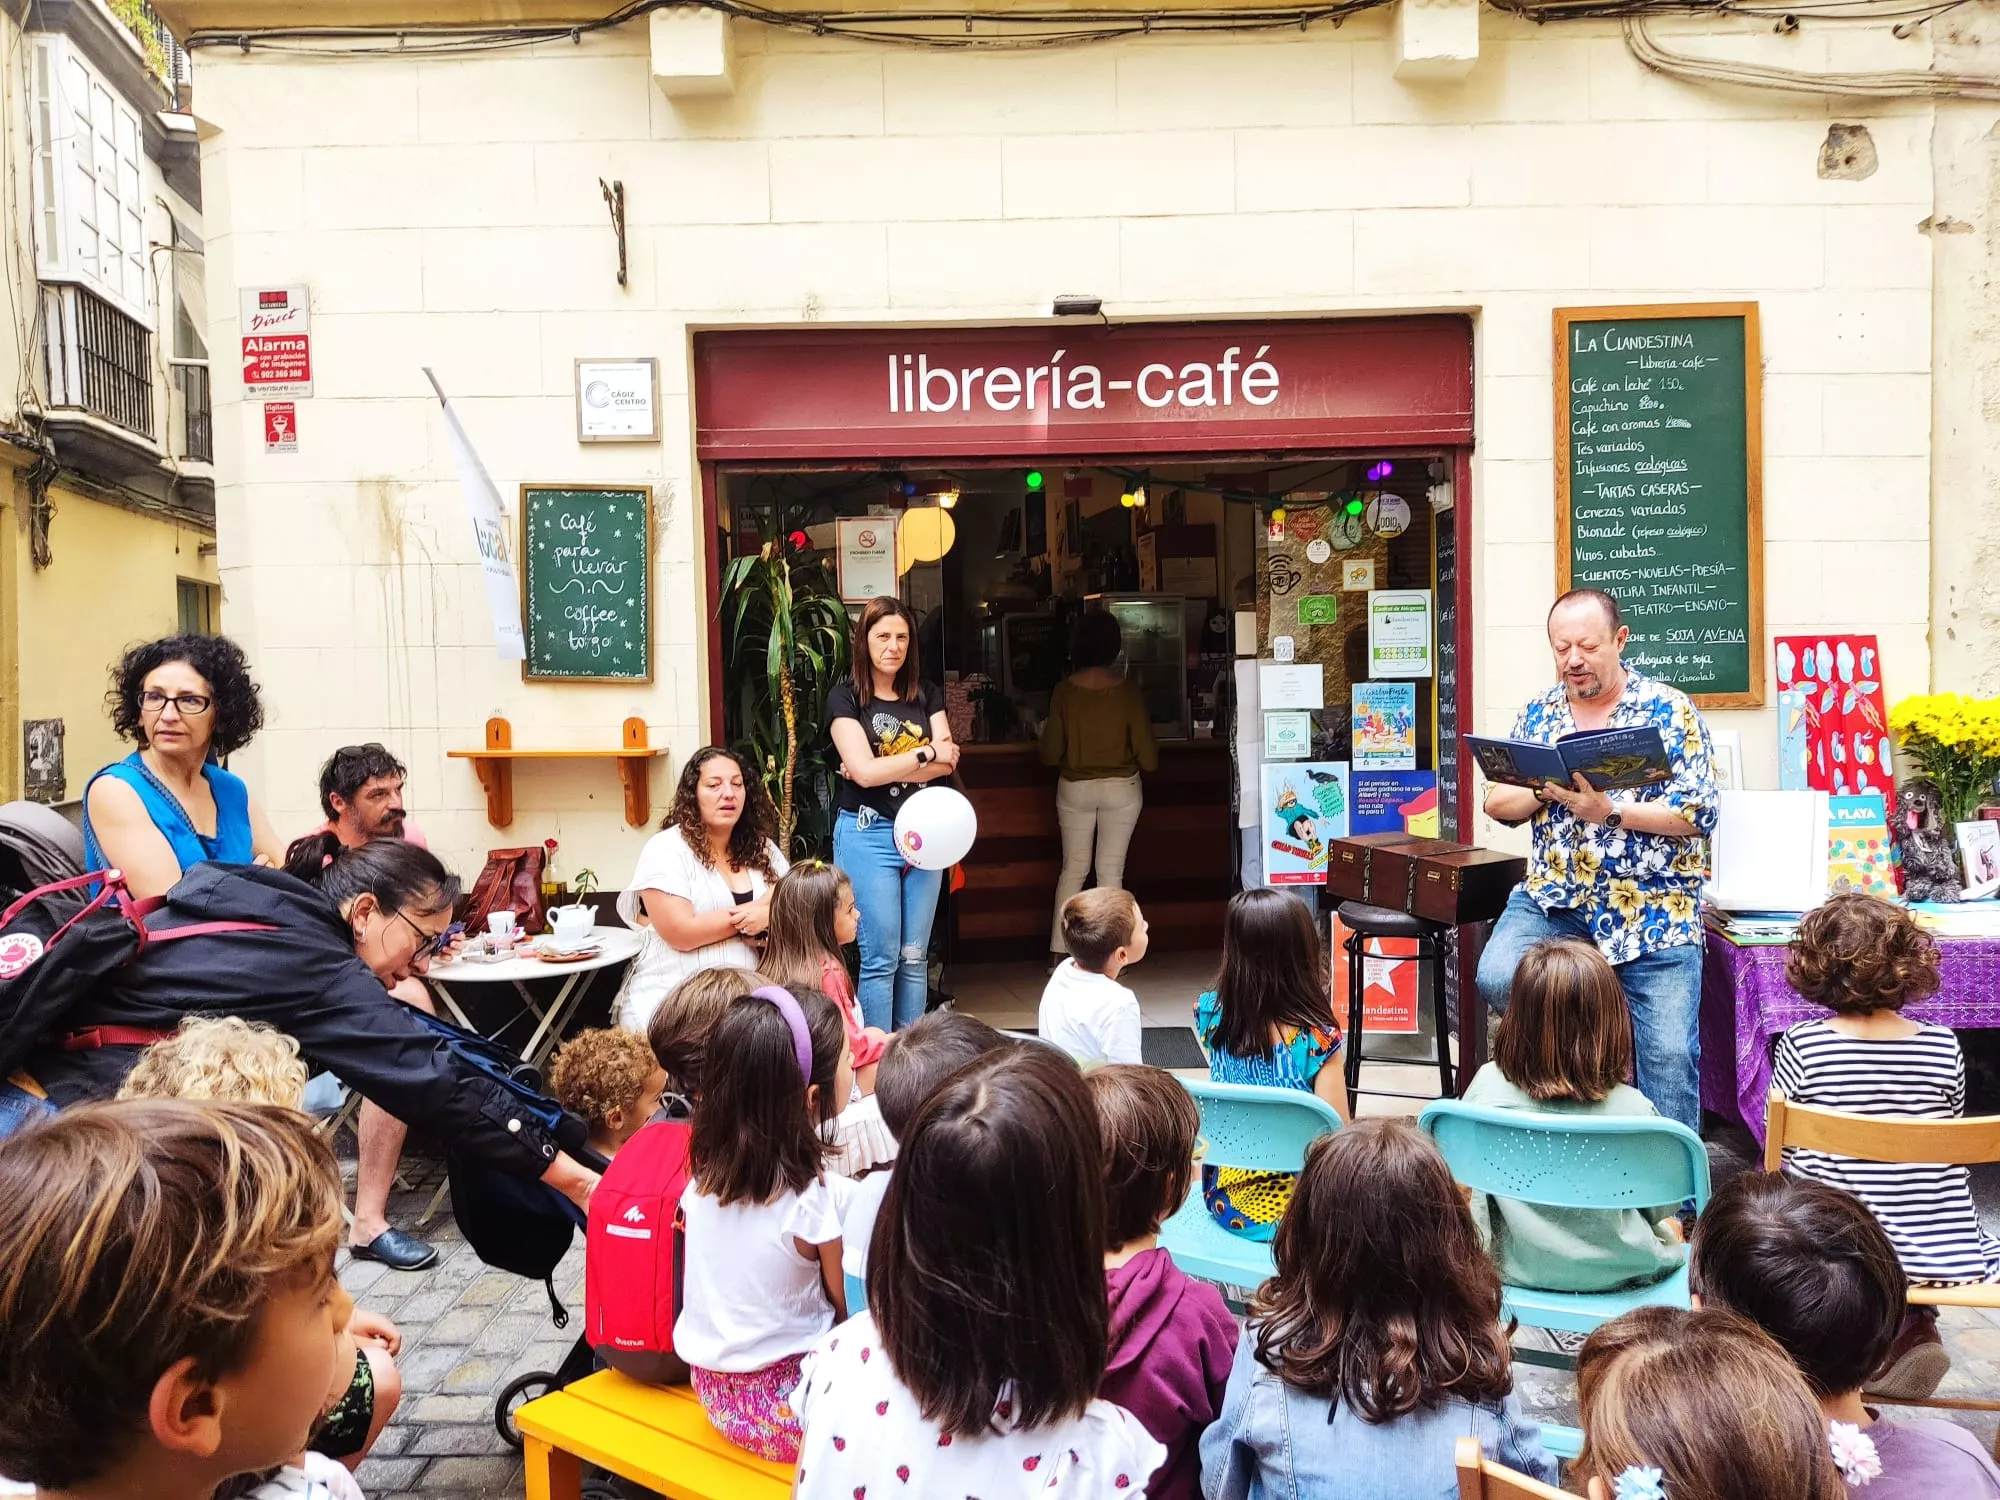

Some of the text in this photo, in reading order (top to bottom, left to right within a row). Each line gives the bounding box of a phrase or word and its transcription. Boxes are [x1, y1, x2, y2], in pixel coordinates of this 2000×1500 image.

[251, 307, 302, 331] Direct
[245, 338, 306, 352] Alarma
[1575, 328, 1694, 353] LA CLANDESTINA
[271, 359, 306, 369] imágenes
[273, 352, 306, 363] grabación
[260, 370, 274, 378] 902
[887, 344, 1280, 413] librería-café
[611, 389, 635, 398] CÁDIZ
[1572, 377, 1597, 396] Café
[1602, 382, 1621, 393] con
[614, 398, 647, 406] CENTRO
[1573, 398, 1629, 420] Capuchino
[1572, 419, 1598, 437] Café
[1602, 421, 1620, 432] con
[1622, 418, 1660, 431] aromas
[1575, 437, 1645, 455] Tés variados
[1575, 455, 1688, 477] Infusiones ecológicas
[1575, 500, 1687, 520] Cervezas variadas
[560, 511, 597, 545] Café
[1577, 521, 1626, 539] Bionade
[553, 544, 601, 568] para
[564, 605, 618, 634] coffee
[568, 630, 611, 658] to go
[1626, 631, 1646, 642] ECHE
[1649, 631, 1660, 642] DE
[1675, 650, 1688, 664] de
[1692, 653, 1713, 670] soja
[1838, 807, 1877, 820] PLAYA
[1363, 1004, 1409, 1015] landestina
[615, 1336, 645, 1347] Quechua
